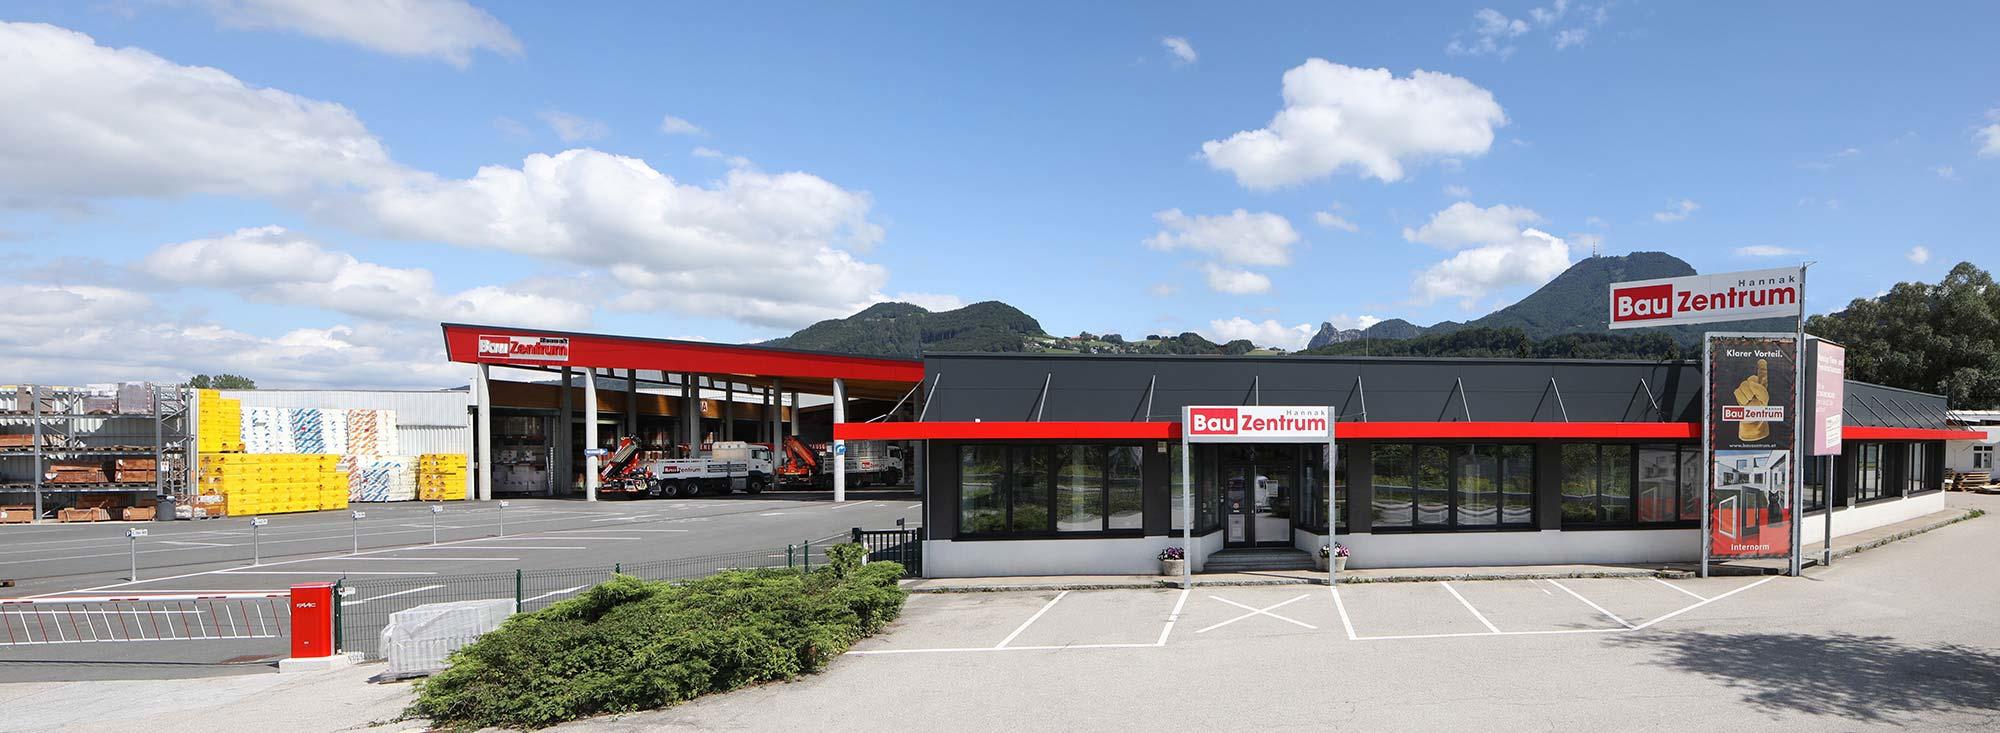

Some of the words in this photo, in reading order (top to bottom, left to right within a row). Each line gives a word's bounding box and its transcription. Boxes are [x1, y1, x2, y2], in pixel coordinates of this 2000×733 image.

[1738, 275, 1796, 287] Hannak
[1618, 295, 1668, 317] Bau
[1677, 286, 1796, 312] Zentrum
[479, 339, 508, 354] Bau
[509, 340, 567, 356] Zentrum
[1726, 349, 1752, 357] Klarer
[1754, 349, 1783, 358] Vorteil.
[1725, 409, 1743, 418] Bau
[1745, 409, 1783, 418] Zentrum
[1193, 414, 1235, 431] Bau
[1241, 414, 1326, 431] Zentrum
[1731, 543, 1770, 551] Internorm
